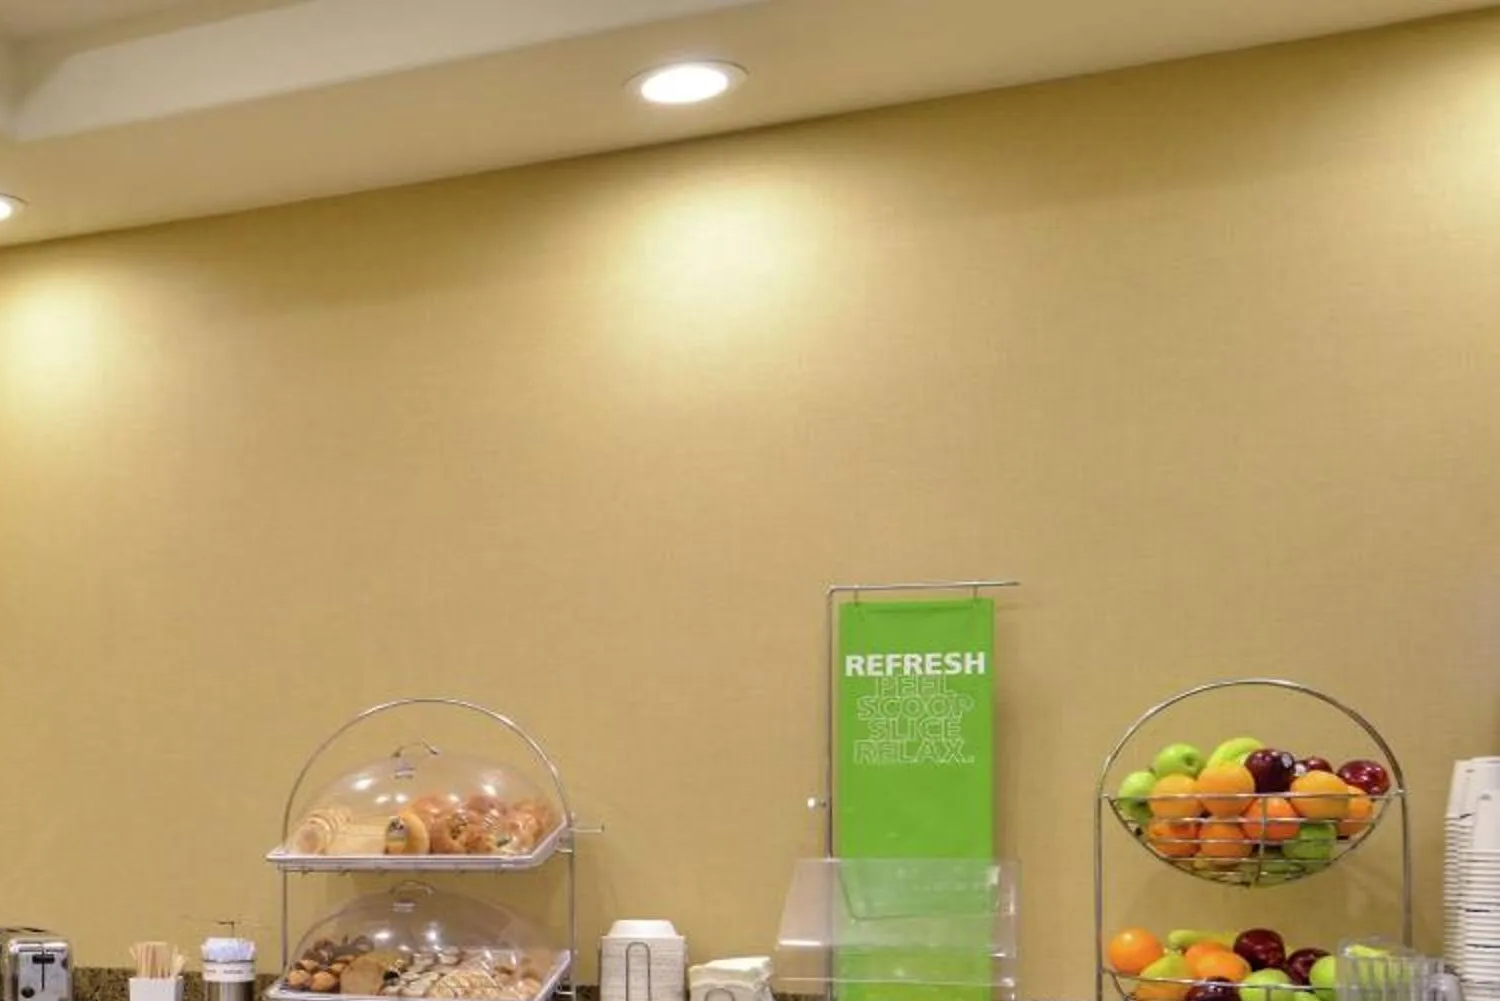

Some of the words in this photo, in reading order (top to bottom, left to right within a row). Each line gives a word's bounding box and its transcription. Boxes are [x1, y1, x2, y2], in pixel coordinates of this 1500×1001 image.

[845, 652, 986, 677] REFRESH
[857, 694, 975, 721] SCOOP
[868, 717, 962, 742] SLICE
